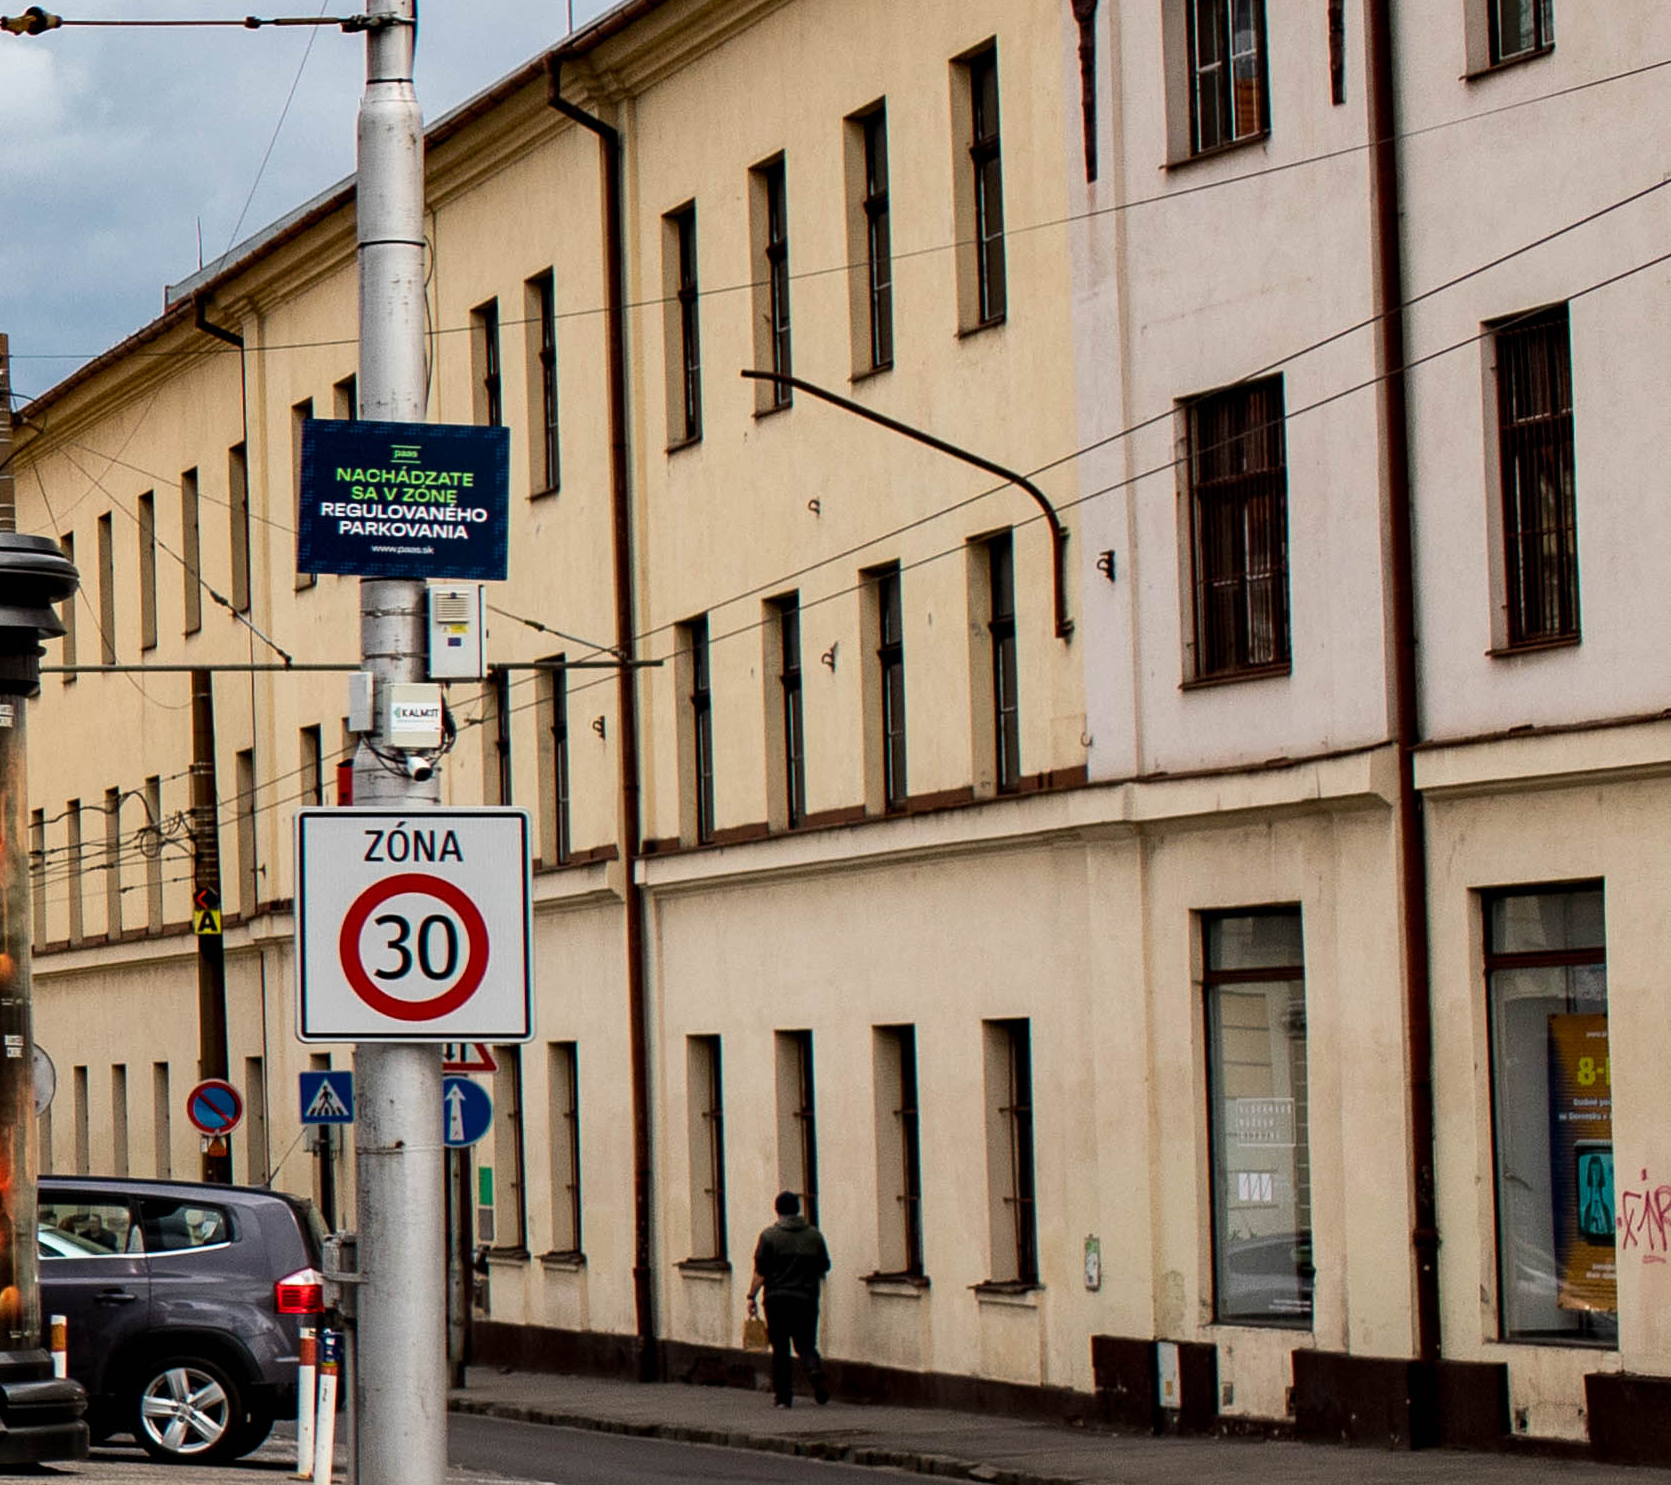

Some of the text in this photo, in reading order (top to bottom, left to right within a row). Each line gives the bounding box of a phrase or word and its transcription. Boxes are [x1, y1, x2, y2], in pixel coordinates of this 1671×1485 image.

[393, 449, 419, 459] paas
[335, 465, 475, 487] NACHÁDZATE
[351, 485, 458, 503] SA V ZÓNE
[320, 501, 488, 523] REGULOVANÉHO
[338, 520, 469, 540] PARKOVANIA
[371, 544, 435, 555] www.paas.sk
[363, 821, 465, 863] ZÓNA
[197, 911, 219, 932] A
[374, 914, 458, 981] 30
